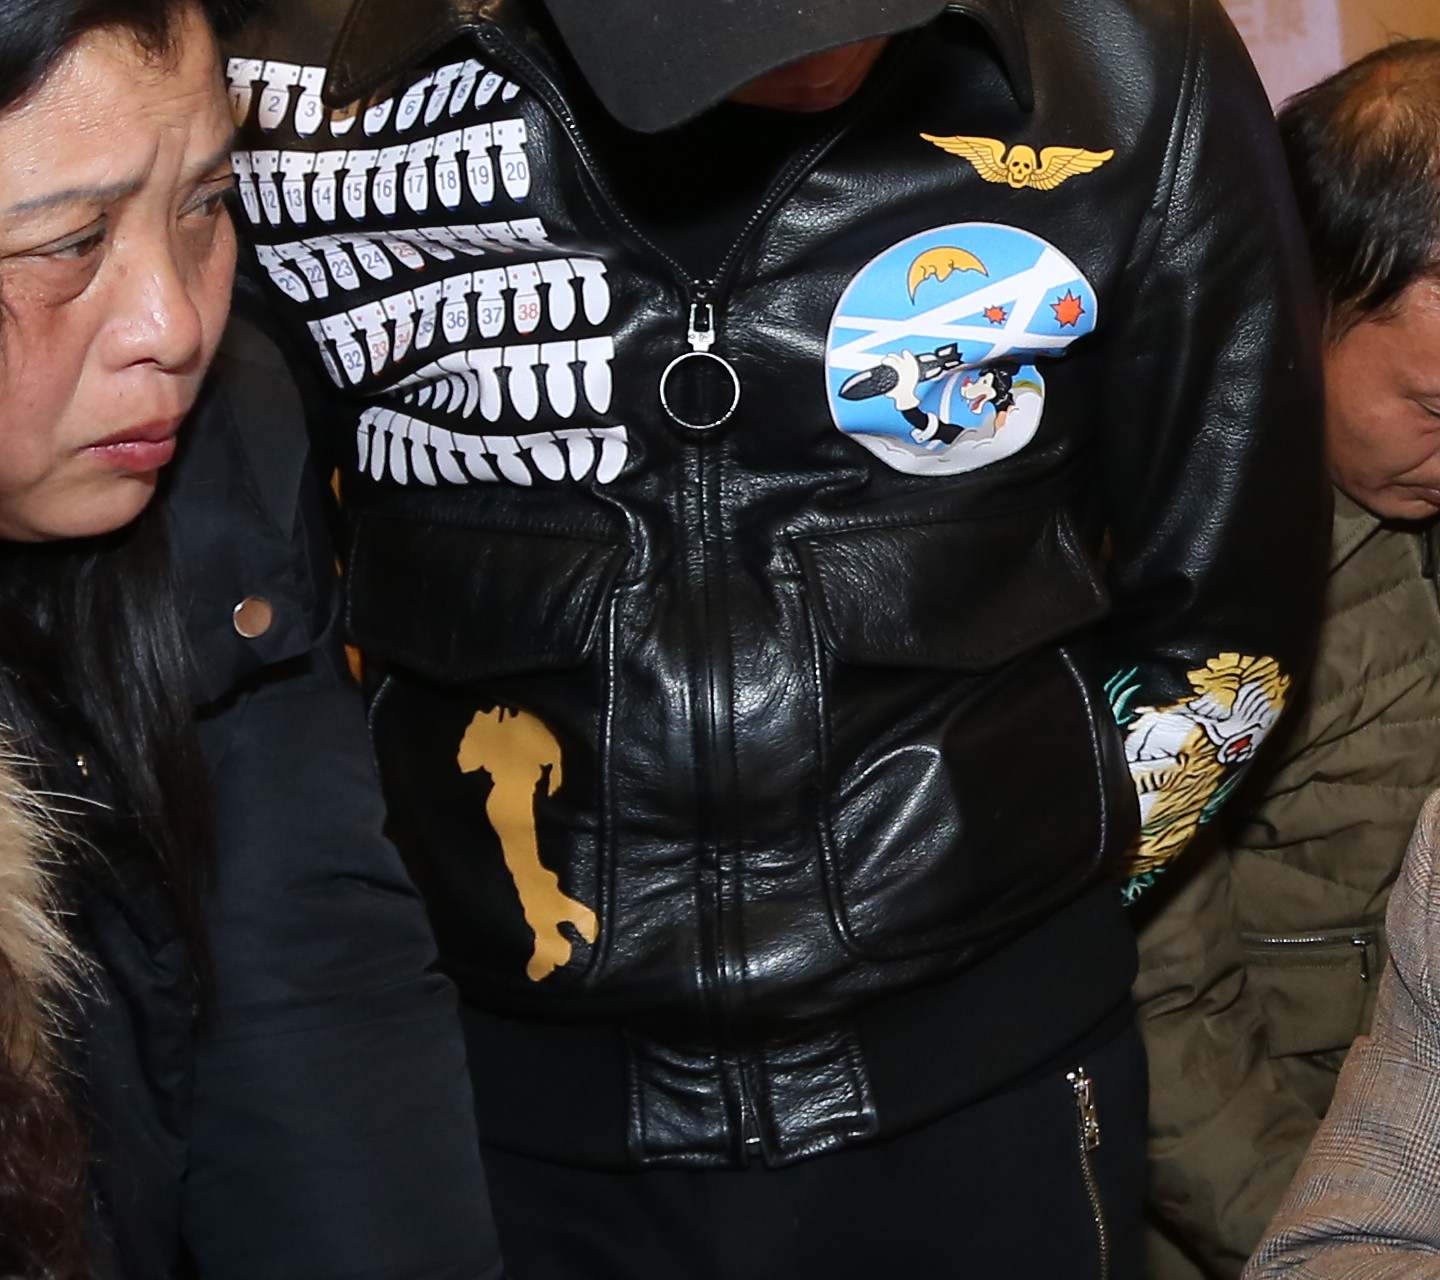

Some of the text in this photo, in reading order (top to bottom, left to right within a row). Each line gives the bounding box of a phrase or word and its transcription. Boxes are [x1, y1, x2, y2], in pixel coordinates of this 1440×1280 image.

[267, 95, 282, 113] 2
[303, 100, 318, 118] 3
[403, 99, 416, 116] 6
[483, 76, 497, 92] 9
[242, 160, 527, 209] 11 12 13 14 15 16 17 18 19 20
[278, 273, 301, 291] 21
[305, 266, 325, 284] 22
[331, 258, 354, 279] 23
[361, 250, 386, 270] 24
[343, 349, 363, 370] 32
[371, 340, 389, 361] 33
[445, 309, 467, 329] 36
[480, 306, 503, 326] 37
[516, 302, 540, 321] 38
